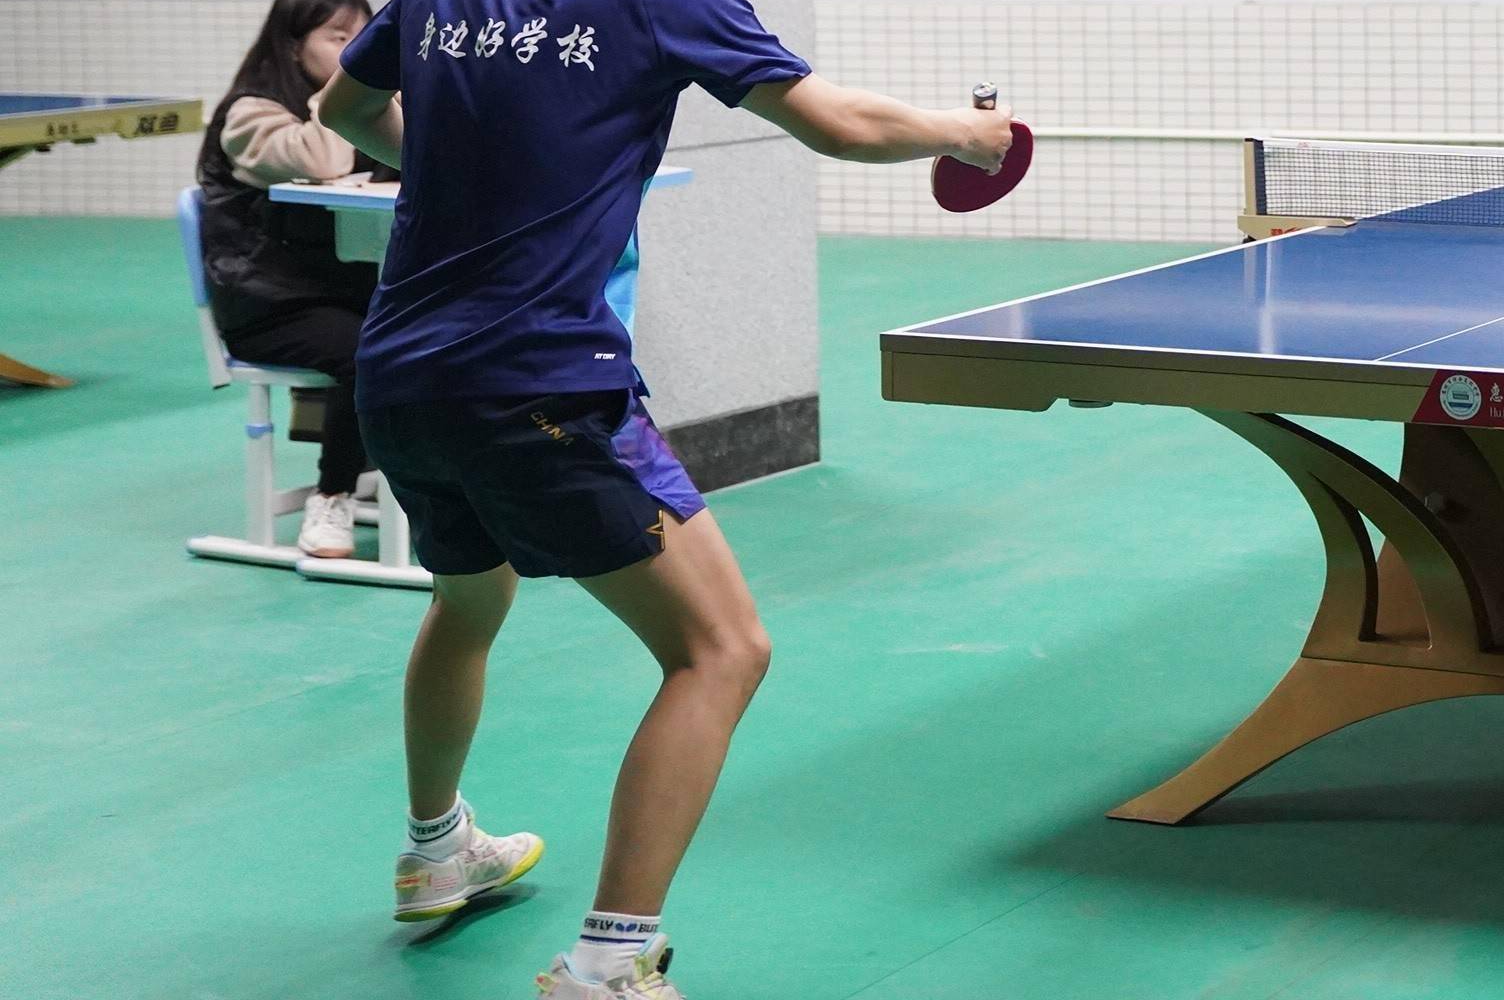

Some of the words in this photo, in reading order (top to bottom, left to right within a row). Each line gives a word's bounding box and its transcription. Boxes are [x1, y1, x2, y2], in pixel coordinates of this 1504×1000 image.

[417, 12, 599, 71] 身边好学校
